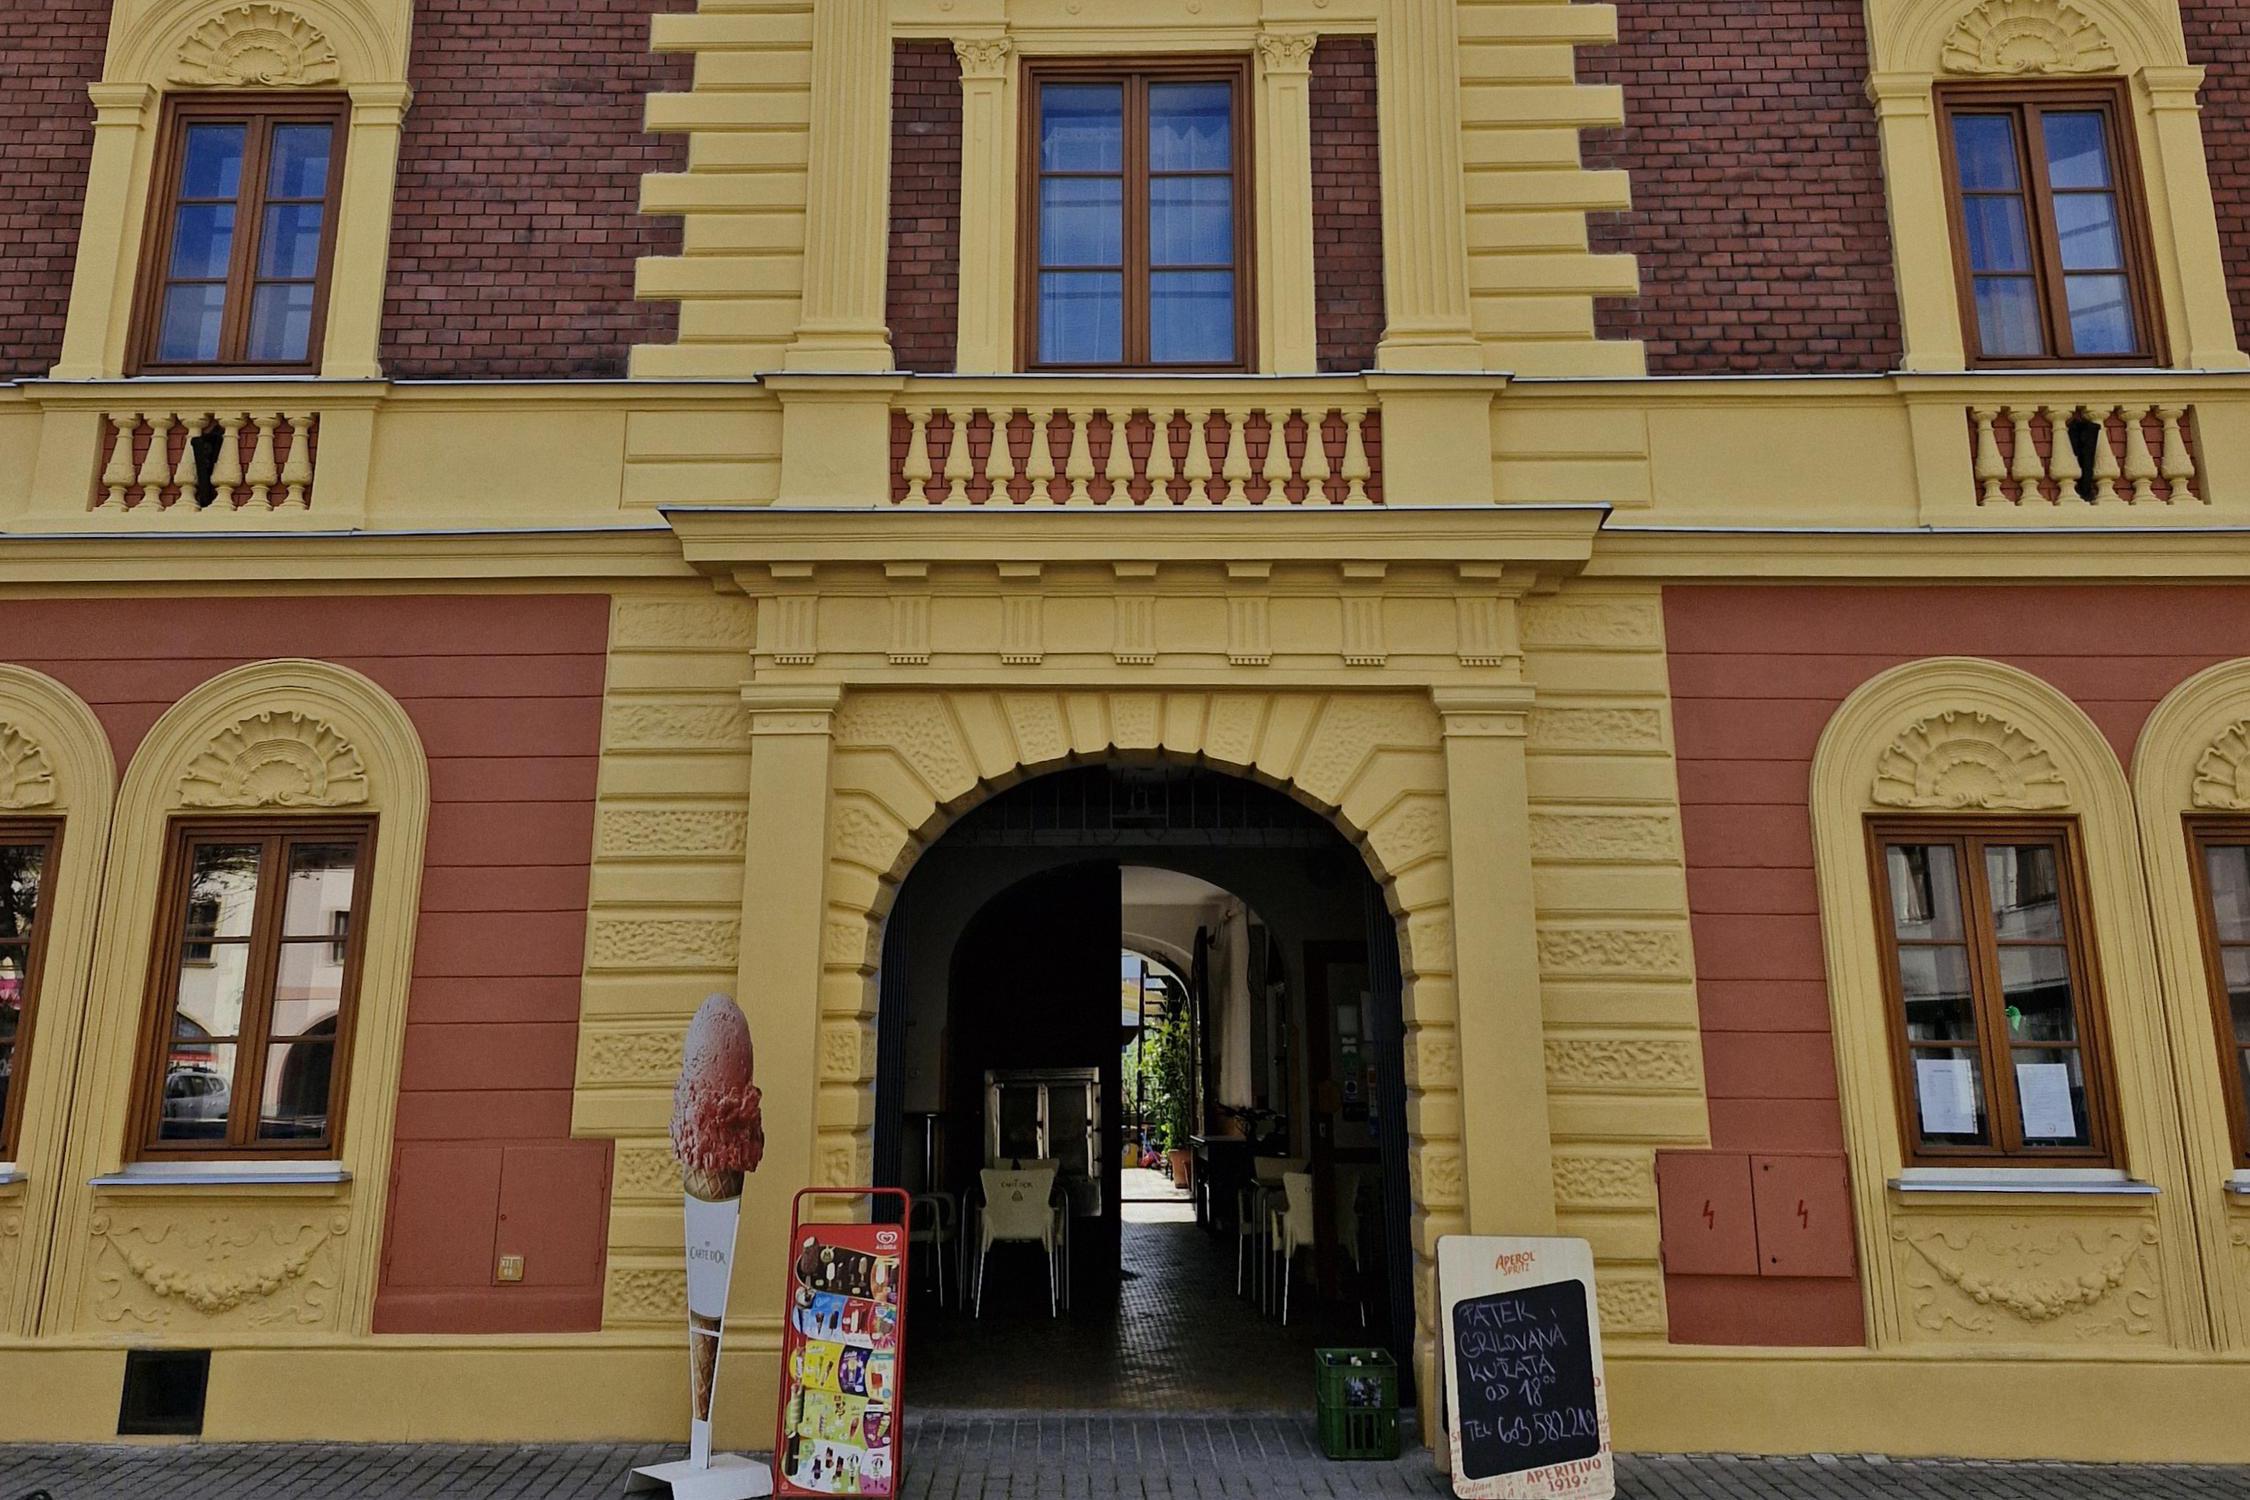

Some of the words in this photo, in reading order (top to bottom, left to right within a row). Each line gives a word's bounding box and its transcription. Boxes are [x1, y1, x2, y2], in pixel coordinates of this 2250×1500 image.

[690, 1246, 709, 1261] CARTE
[1495, 1251, 1536, 1271] APEROL
[1485, 1384, 1510, 1401] OD
[1498, 1416, 1532, 1447] 603
[1533, 1410, 1571, 1445] 582
[1526, 1458, 1602, 1485] APERITIVO
